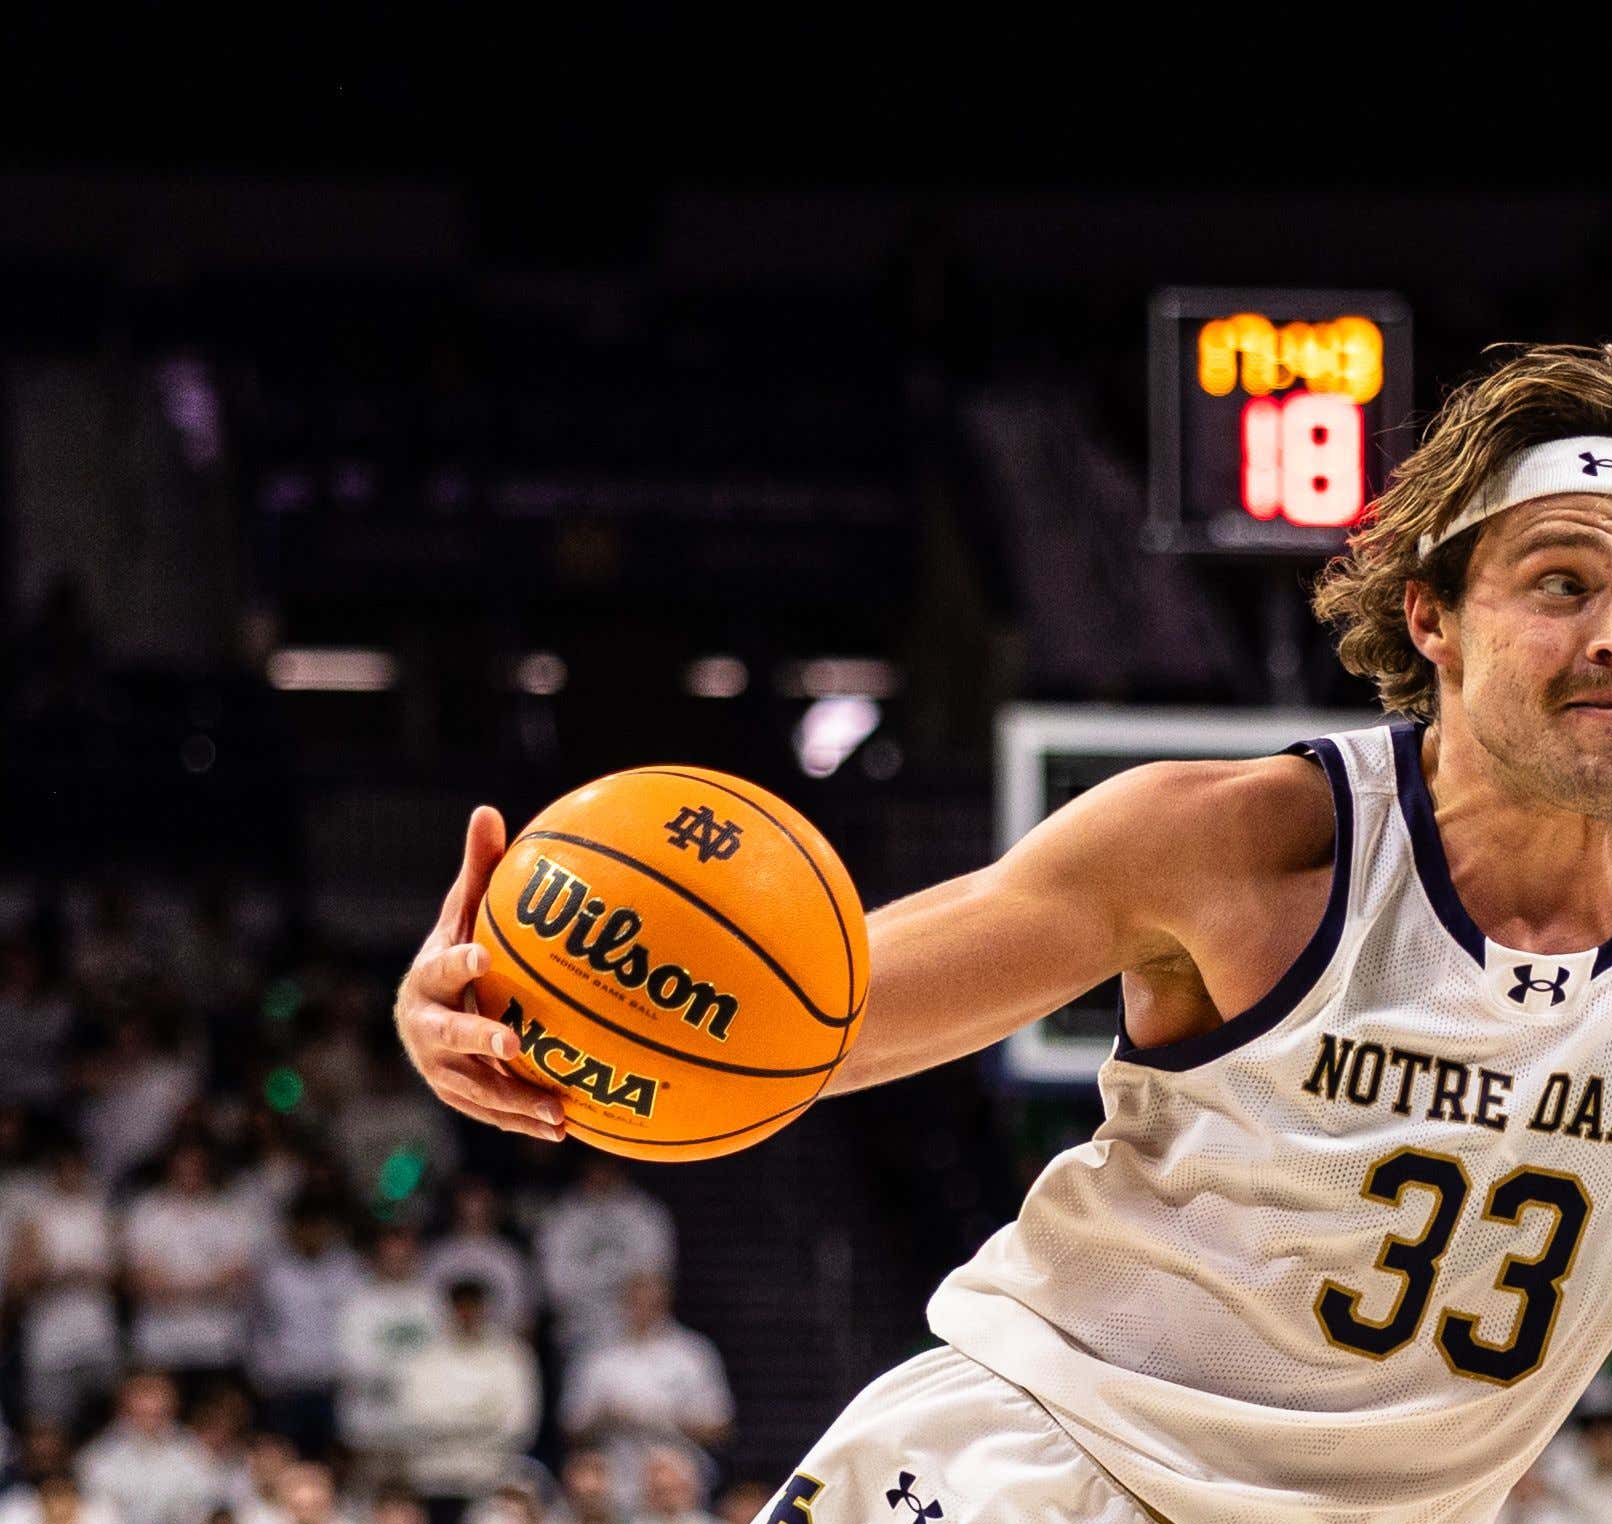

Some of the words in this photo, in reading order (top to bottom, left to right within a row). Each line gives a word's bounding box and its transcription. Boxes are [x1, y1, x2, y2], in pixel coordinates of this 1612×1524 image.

[1240, 390, 1365, 527] 18
[516, 855, 740, 1042] Wilson
[501, 996, 659, 1119] NCAA
[1301, 1032, 1514, 1133] NOTRE
[1312, 1145, 1594, 1389] 33
